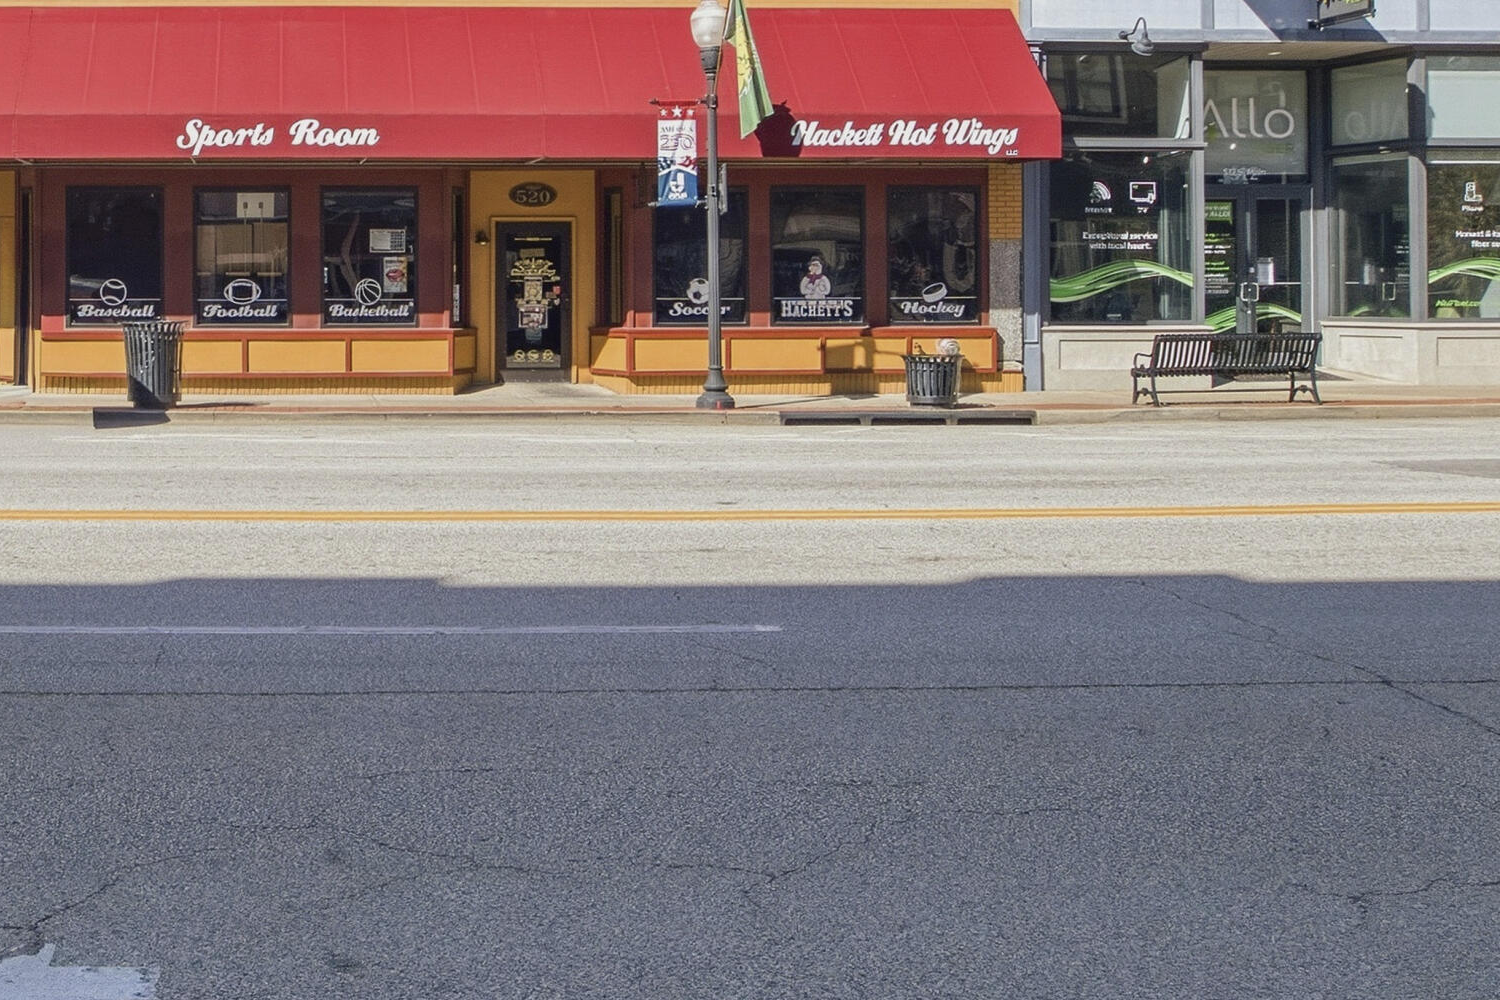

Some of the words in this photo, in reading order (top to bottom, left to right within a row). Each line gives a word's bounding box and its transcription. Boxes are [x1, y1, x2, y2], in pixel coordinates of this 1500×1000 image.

[1203, 97, 1295, 139] Allo
[175, 118, 275, 157] Sports
[288, 118, 380, 147] Room
[790, 119, 884, 147] Hackett
[888, 119, 938, 146] Hot
[941, 117, 1019, 155] Wings
[515, 190, 550, 203] 520
[77, 304, 155, 318] Baseball
[203, 304, 278, 318] Football
[329, 303, 410, 317] Basketball
[669, 302, 731, 317] Soccr
[901, 301, 965, 318] Hockey
